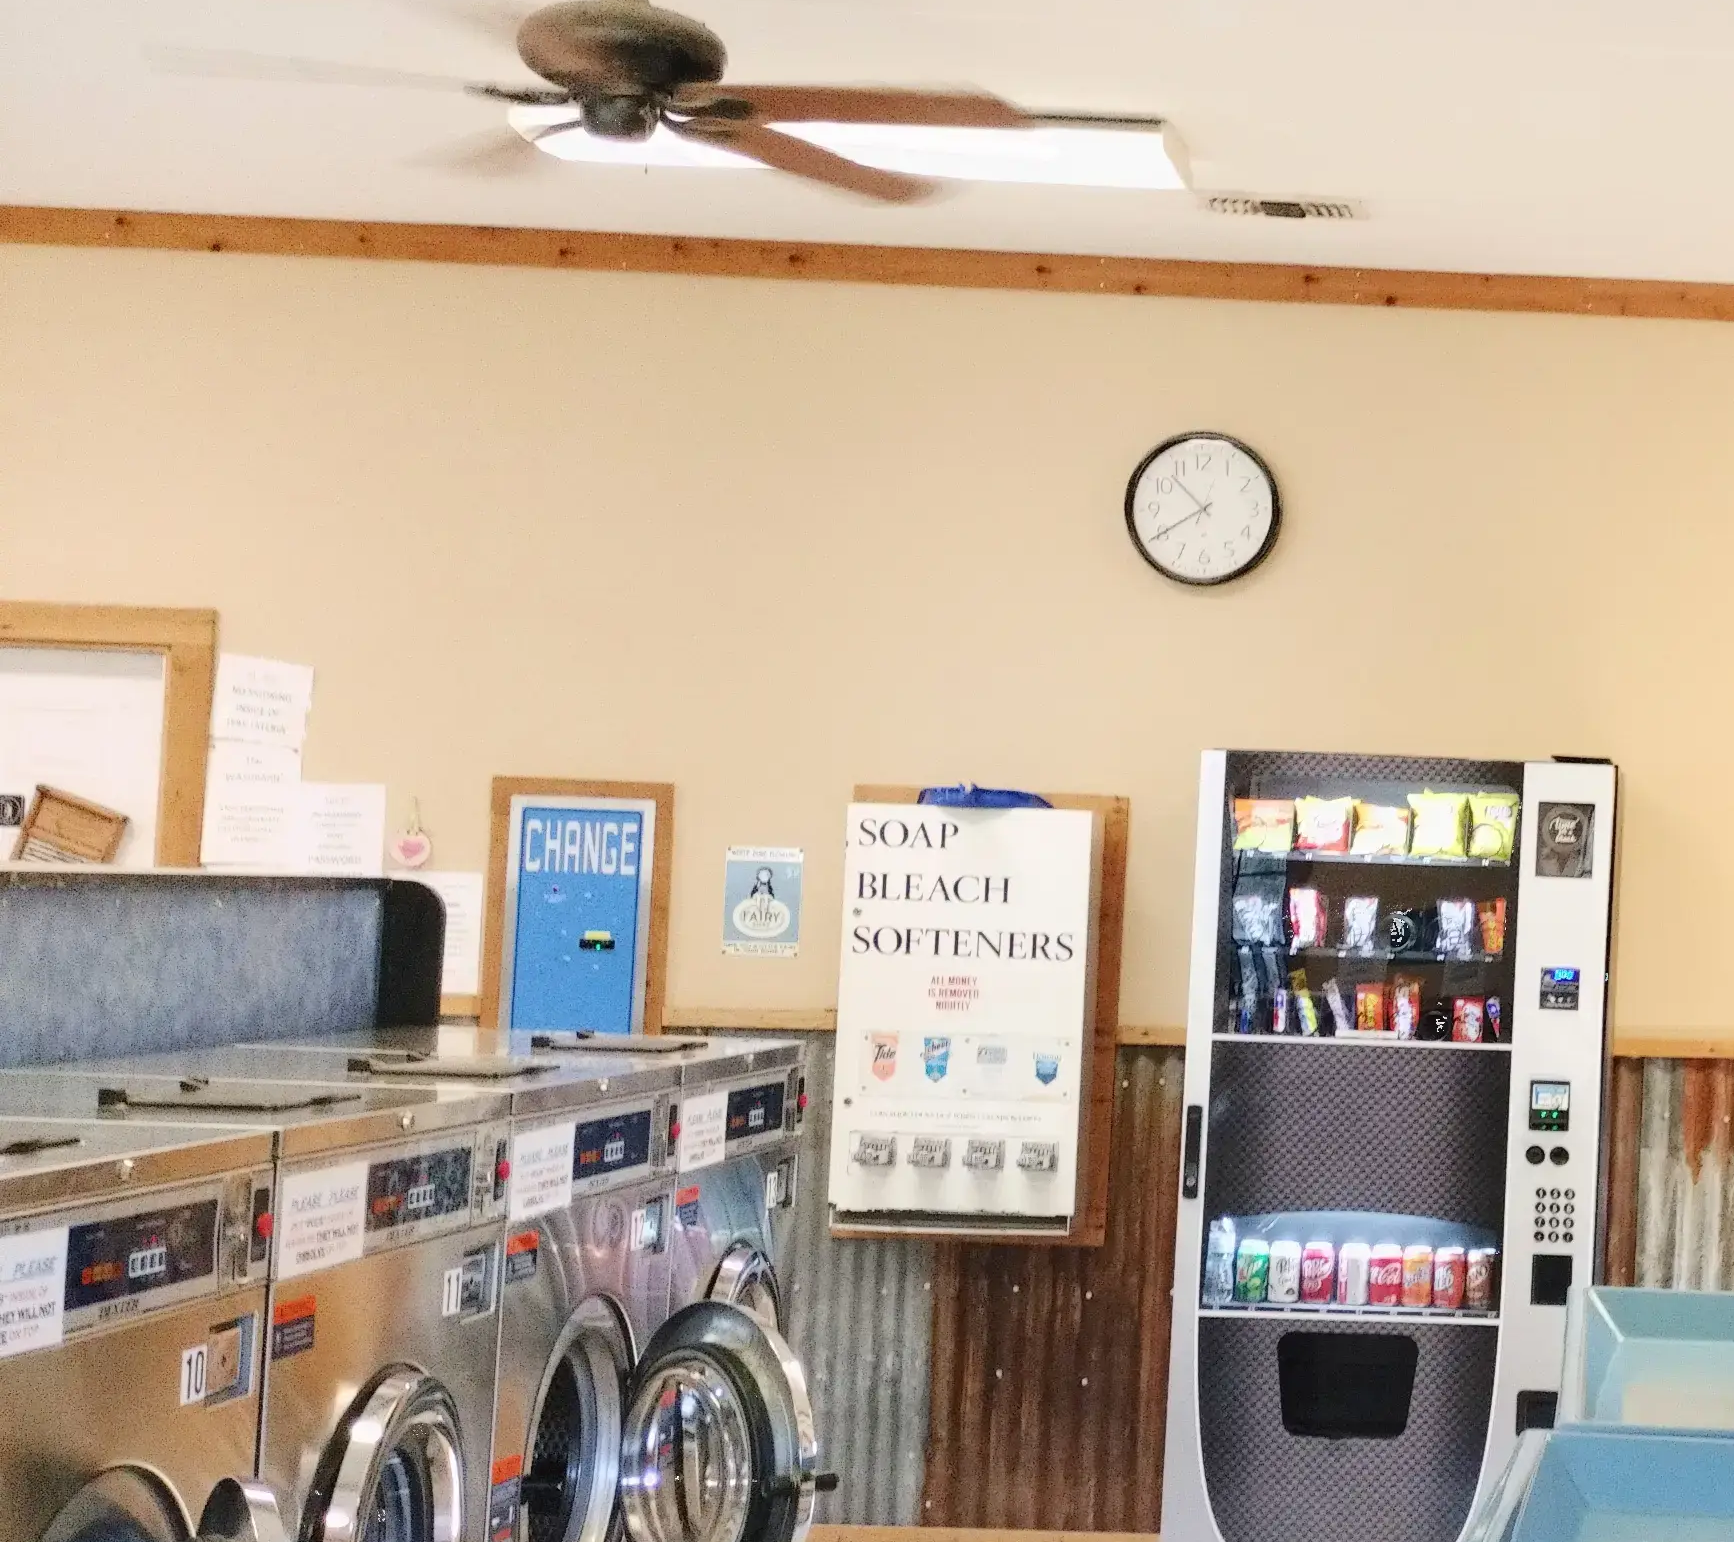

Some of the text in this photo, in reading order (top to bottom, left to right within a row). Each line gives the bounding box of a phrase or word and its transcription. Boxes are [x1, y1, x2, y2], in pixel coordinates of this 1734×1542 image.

[1175, 460, 1186, 477] 11
[1196, 454, 1211, 471] 12
[1156, 477, 1172, 494] 10
[1239, 476, 1251, 493] 2
[1148, 501, 1160, 519] 9
[1250, 500, 1259, 518] 3
[1240, 525, 1250, 540] 4
[1176, 542, 1186, 560] 7
[1198, 549, 1211, 565] 6
[1224, 541, 1235, 557] 5
[858, 818, 959, 849] SOAP
[524, 818, 639, 876] CHANGE
[857, 871, 1013, 904] BLEACH
[743, 909, 781, 923] FAIRY
[852, 925, 1075, 962] SOFTENERS
[938, 989, 980, 1000] REMOVED
[873, 1042, 897, 1063] Tide
[13, 1256, 57, 1278] PLEASE
[446, 1271, 460, 1313] 11
[39, 1301, 56, 1318] NOT
[186, 1350, 205, 1400] 10
